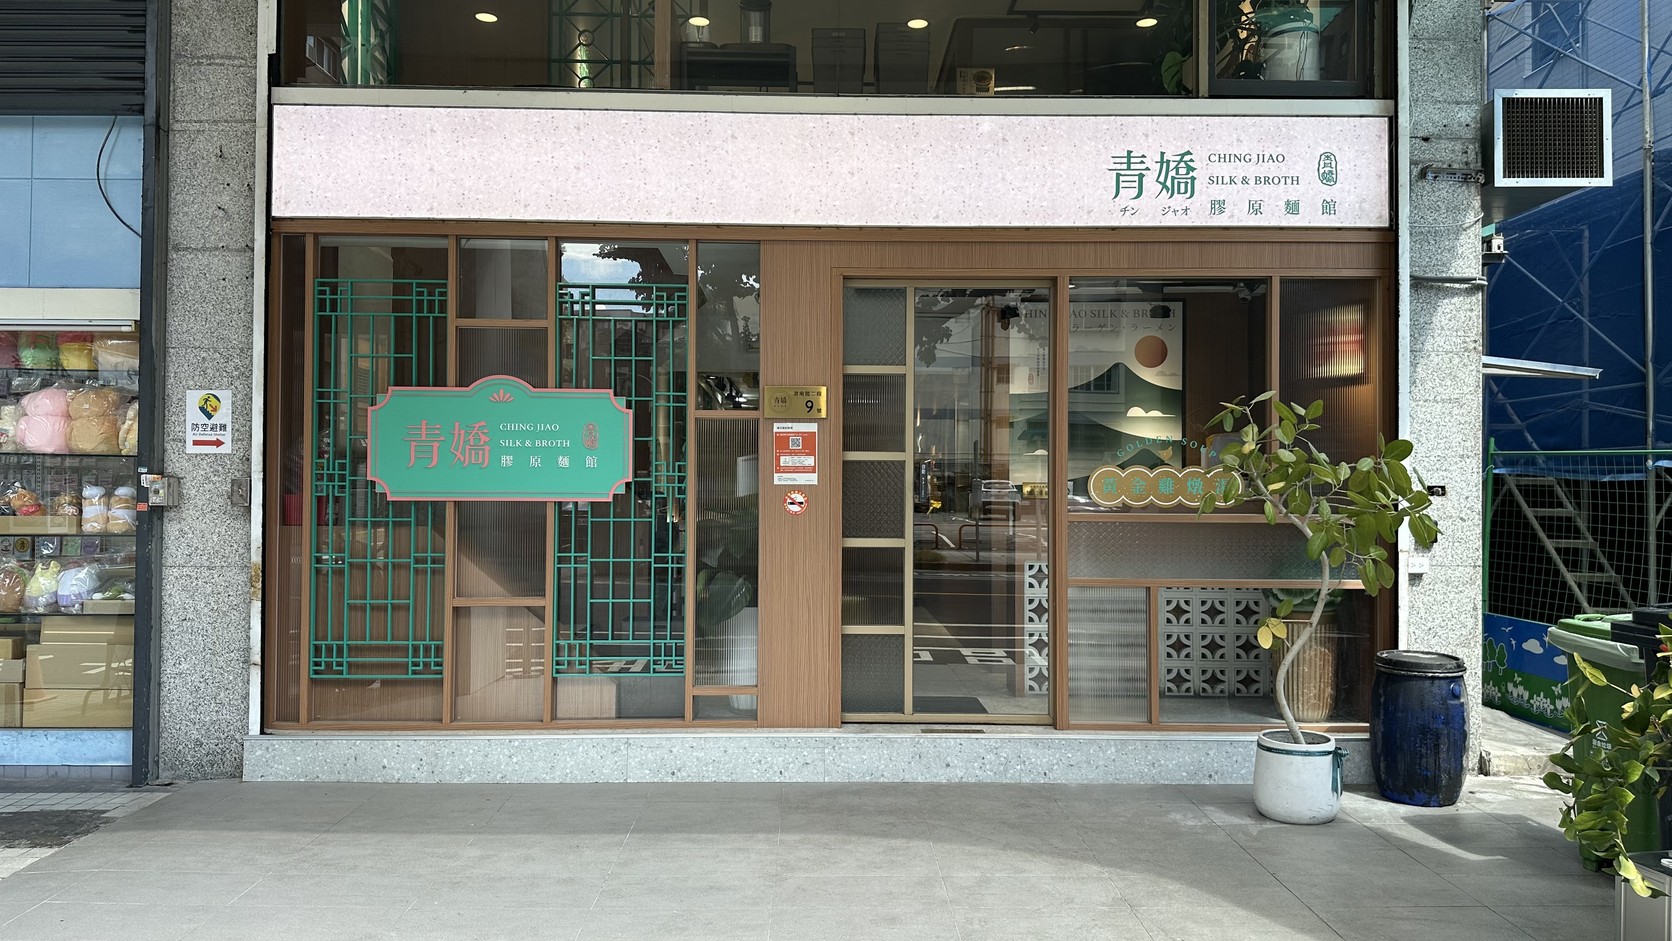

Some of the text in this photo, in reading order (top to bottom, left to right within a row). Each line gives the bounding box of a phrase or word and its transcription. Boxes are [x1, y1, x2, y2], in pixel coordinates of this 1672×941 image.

[1207, 153, 1286, 166] CHING JIAO
[1106, 149, 1198, 201] 青嬌
[1207, 175, 1300, 186] SILK & BROTH
[1119, 205, 1191, 217] チン ジャオ
[1209, 199, 1338, 216] 膠原麵館
[1090, 309, 1118, 319] SILK
[1120, 309, 1130, 319] &
[1133, 309, 1176, 319] BRH
[804, 399, 814, 414] 9
[499, 422, 560, 432] CHING JIAO
[403, 419, 492, 469] 青嬌
[499, 439, 570, 448] SILK & BROTH
[1116, 435, 1174, 458] GOLDEN
